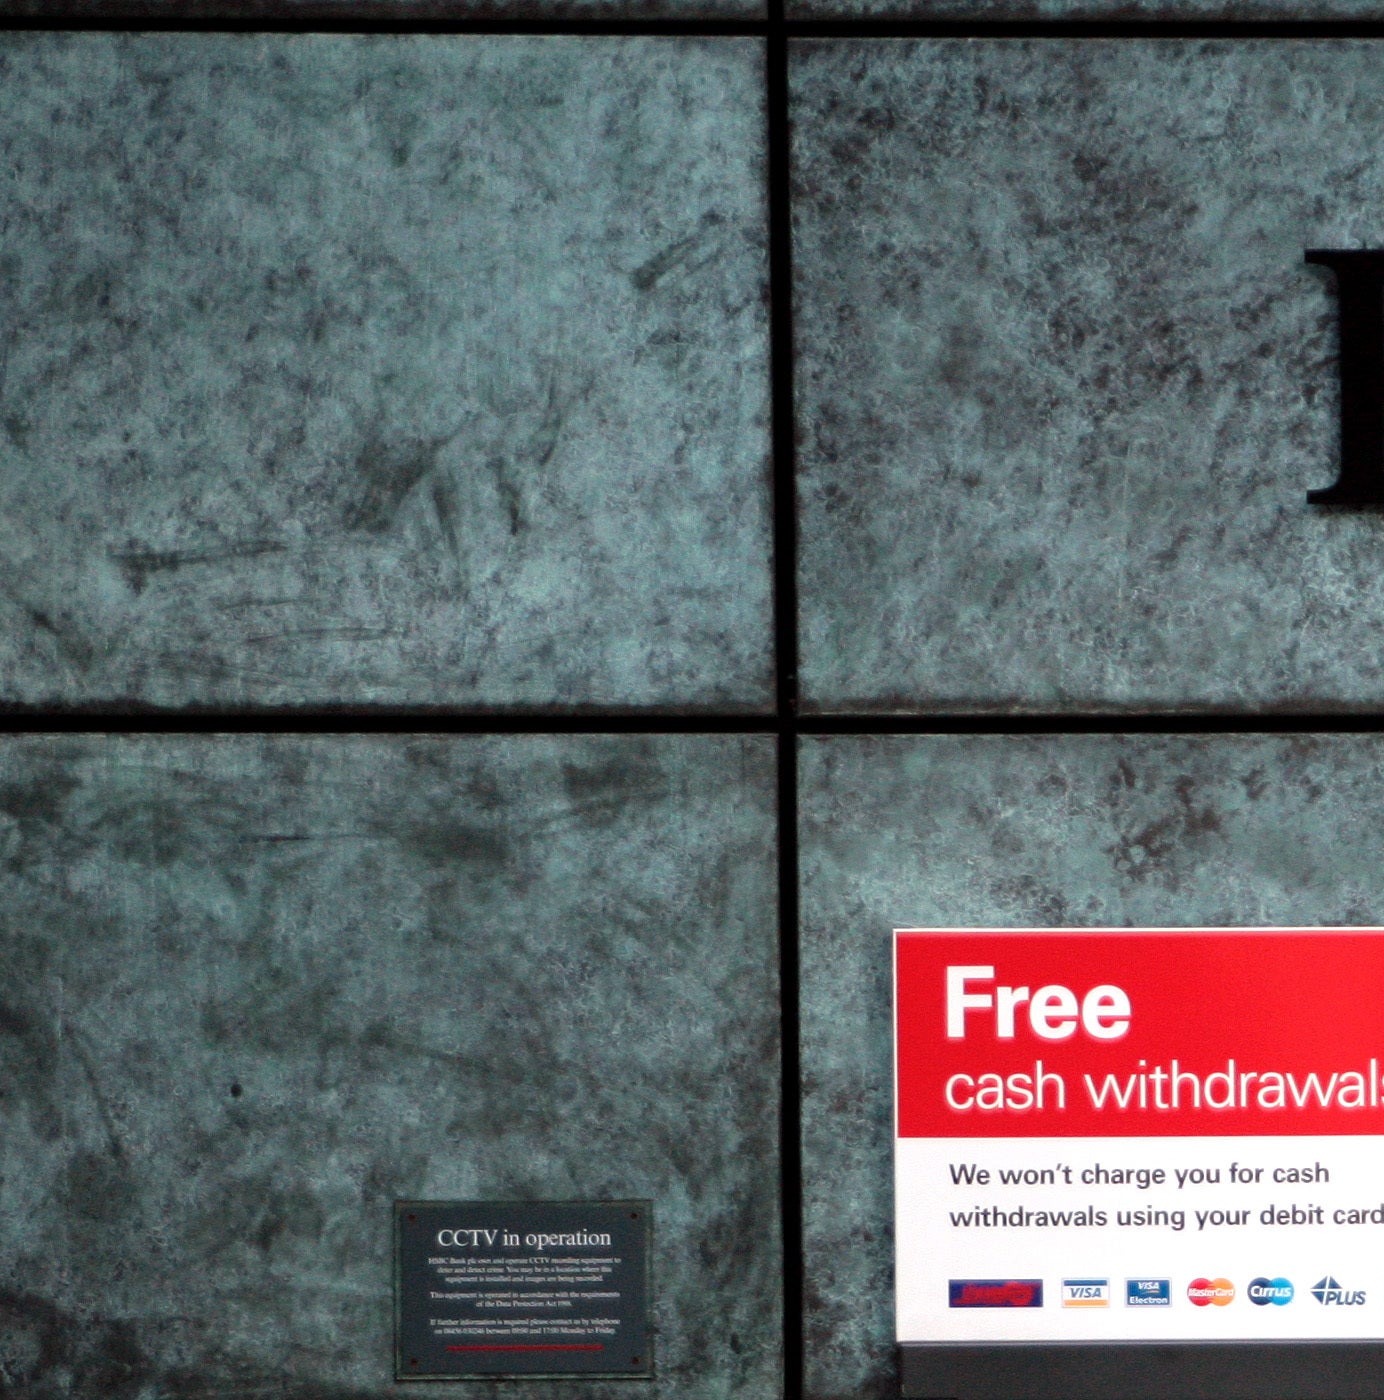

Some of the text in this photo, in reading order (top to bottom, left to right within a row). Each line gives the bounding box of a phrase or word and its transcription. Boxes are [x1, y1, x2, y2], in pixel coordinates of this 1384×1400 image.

[947, 966, 1130, 1039] Free
[946, 1061, 1064, 1109] cash
[949, 1162, 1330, 1190] We won't charge you for cash
[949, 1205, 1108, 1228] withdrawals
[1116, 1204, 1185, 1232] using
[1195, 1210, 1251, 1231] your
[1259, 1203, 1325, 1226] debit
[437, 1228, 611, 1251] CCTV in operation
[1069, 1287, 1103, 1299] VISA
[1137, 1281, 1160, 1290] VISA
[1187, 1287, 1236, 1299] MasterCard
[1250, 1285, 1292, 1298] Cirrus
[1129, 1296, 1169, 1305] Electron
[1325, 1290, 1368, 1306] PLUS
